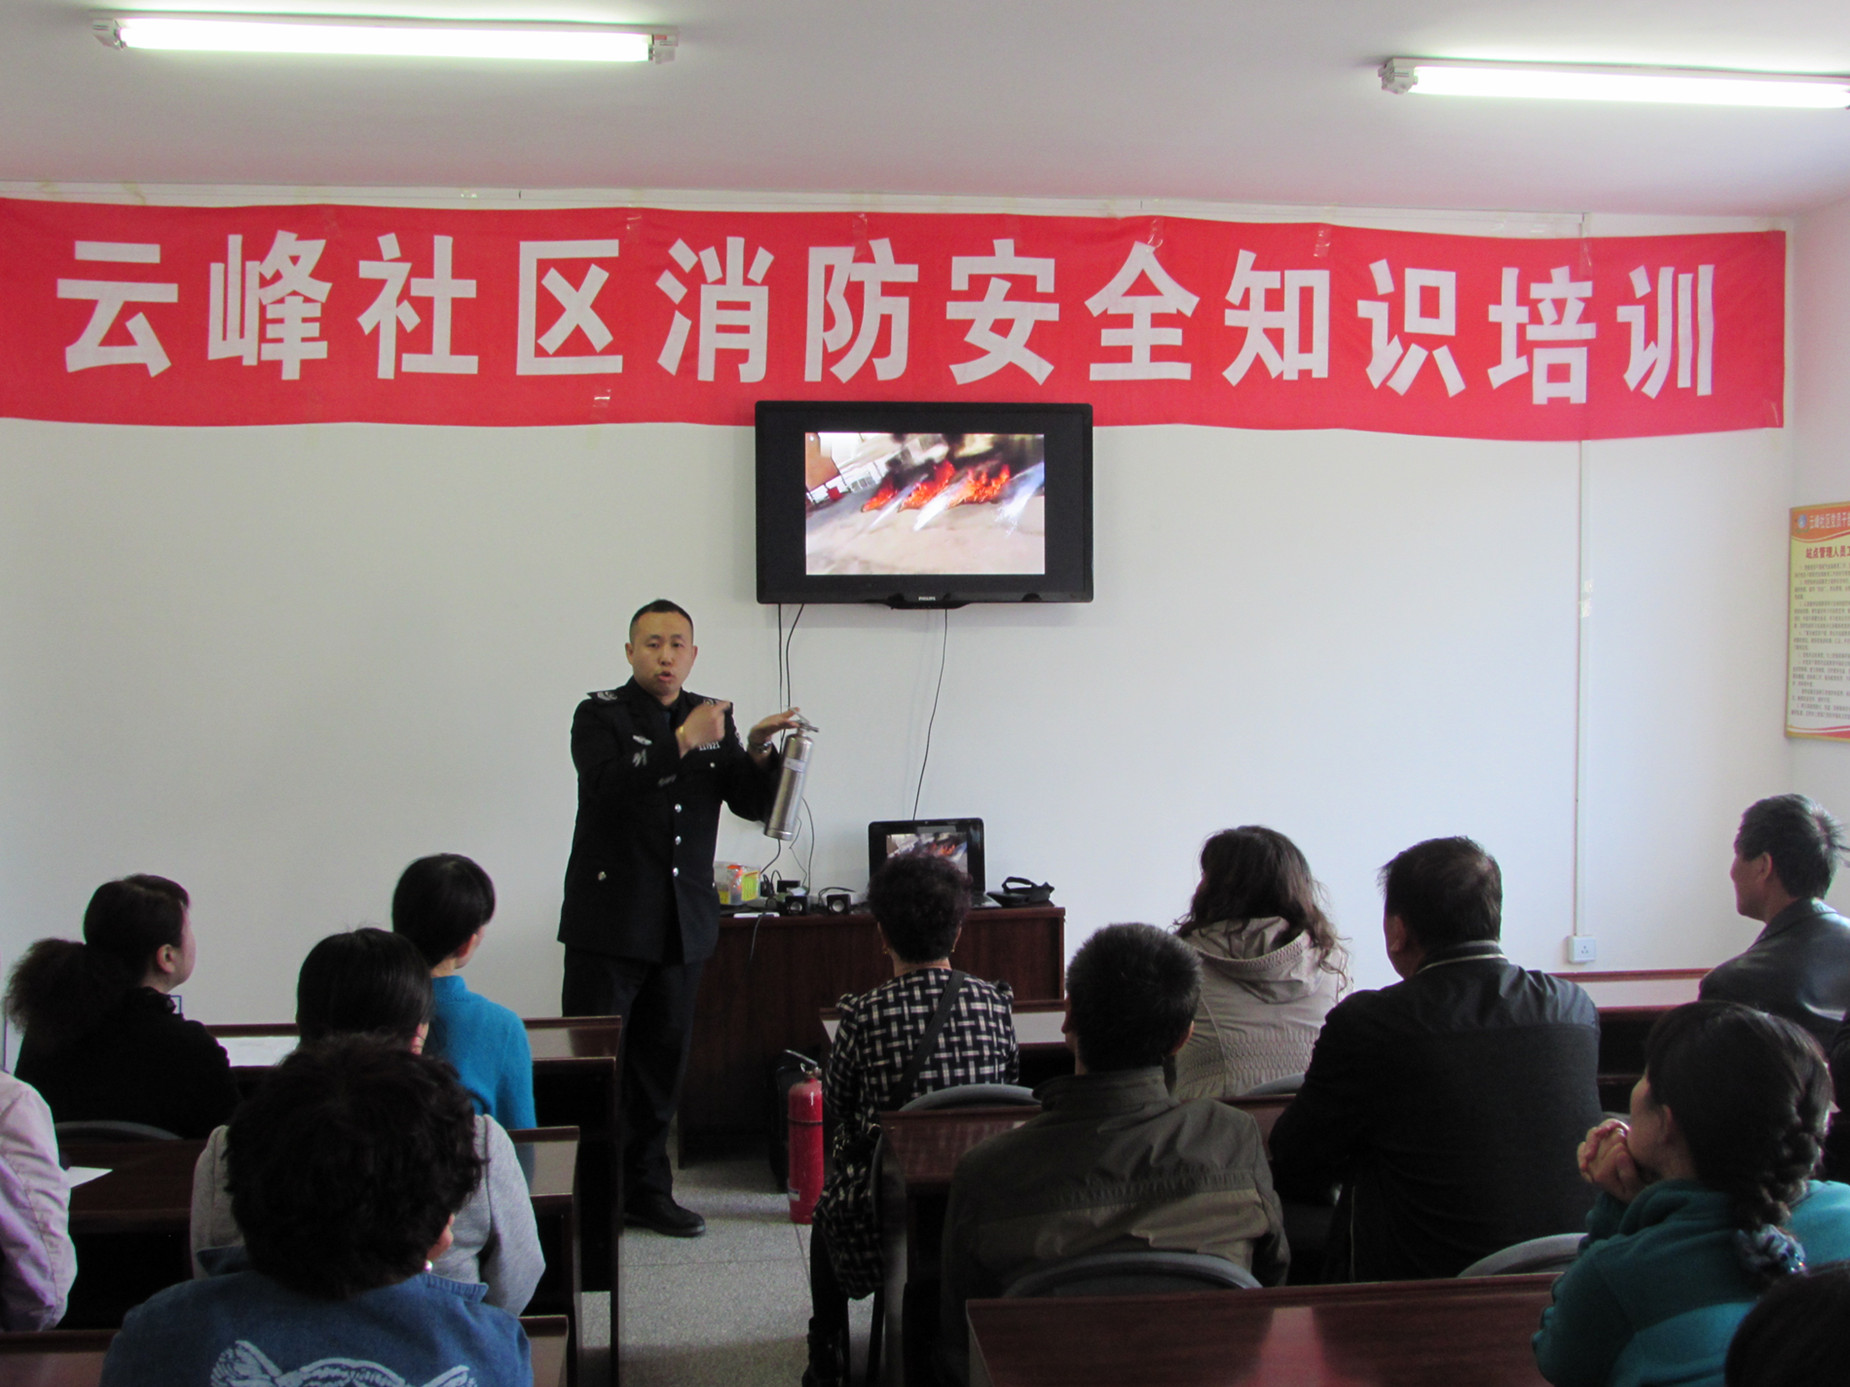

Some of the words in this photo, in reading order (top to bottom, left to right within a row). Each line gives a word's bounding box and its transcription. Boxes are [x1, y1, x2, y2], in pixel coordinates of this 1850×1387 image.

[57, 229, 1714, 405] 云峰社区消防安全知识培训
